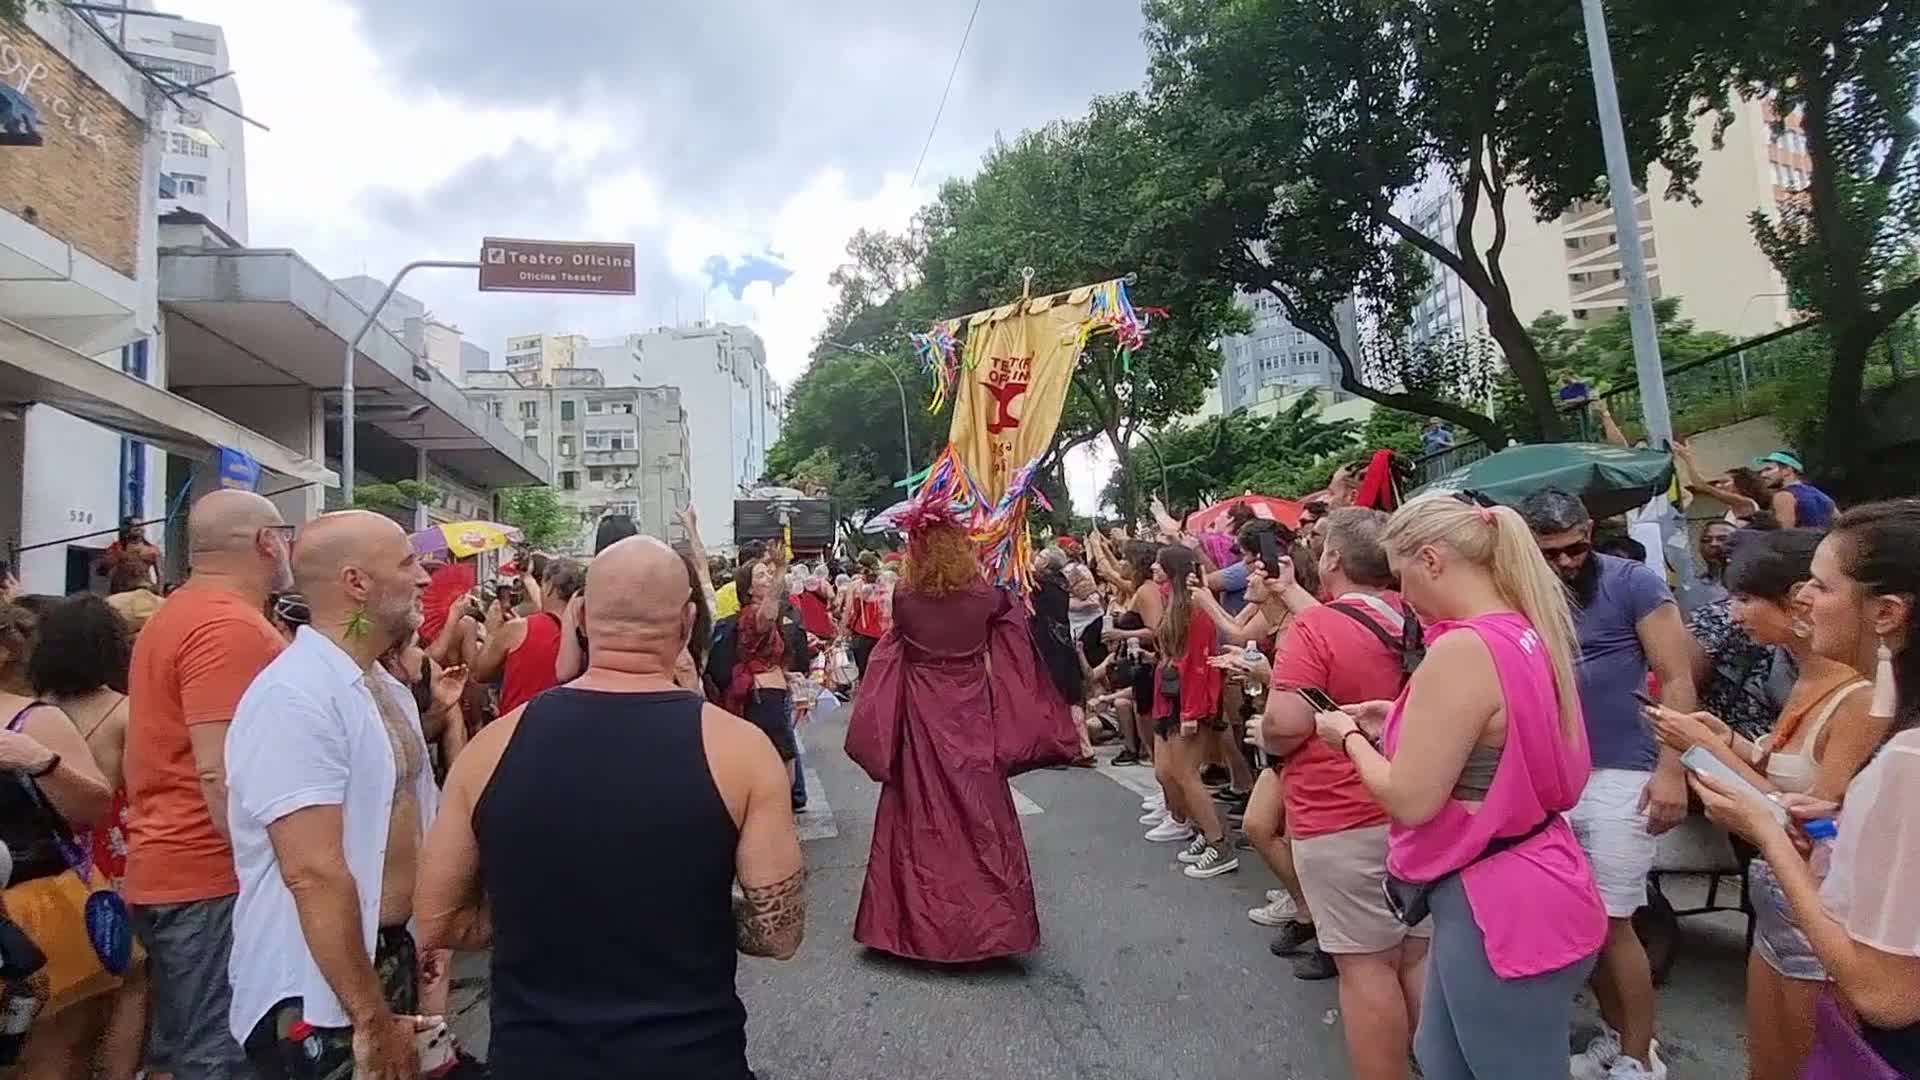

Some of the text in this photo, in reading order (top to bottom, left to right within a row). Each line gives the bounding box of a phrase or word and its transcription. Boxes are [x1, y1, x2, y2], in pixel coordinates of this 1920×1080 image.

[508, 250, 633, 268] Teatro Oficina
[519, 271, 604, 283] Oficina Theater
